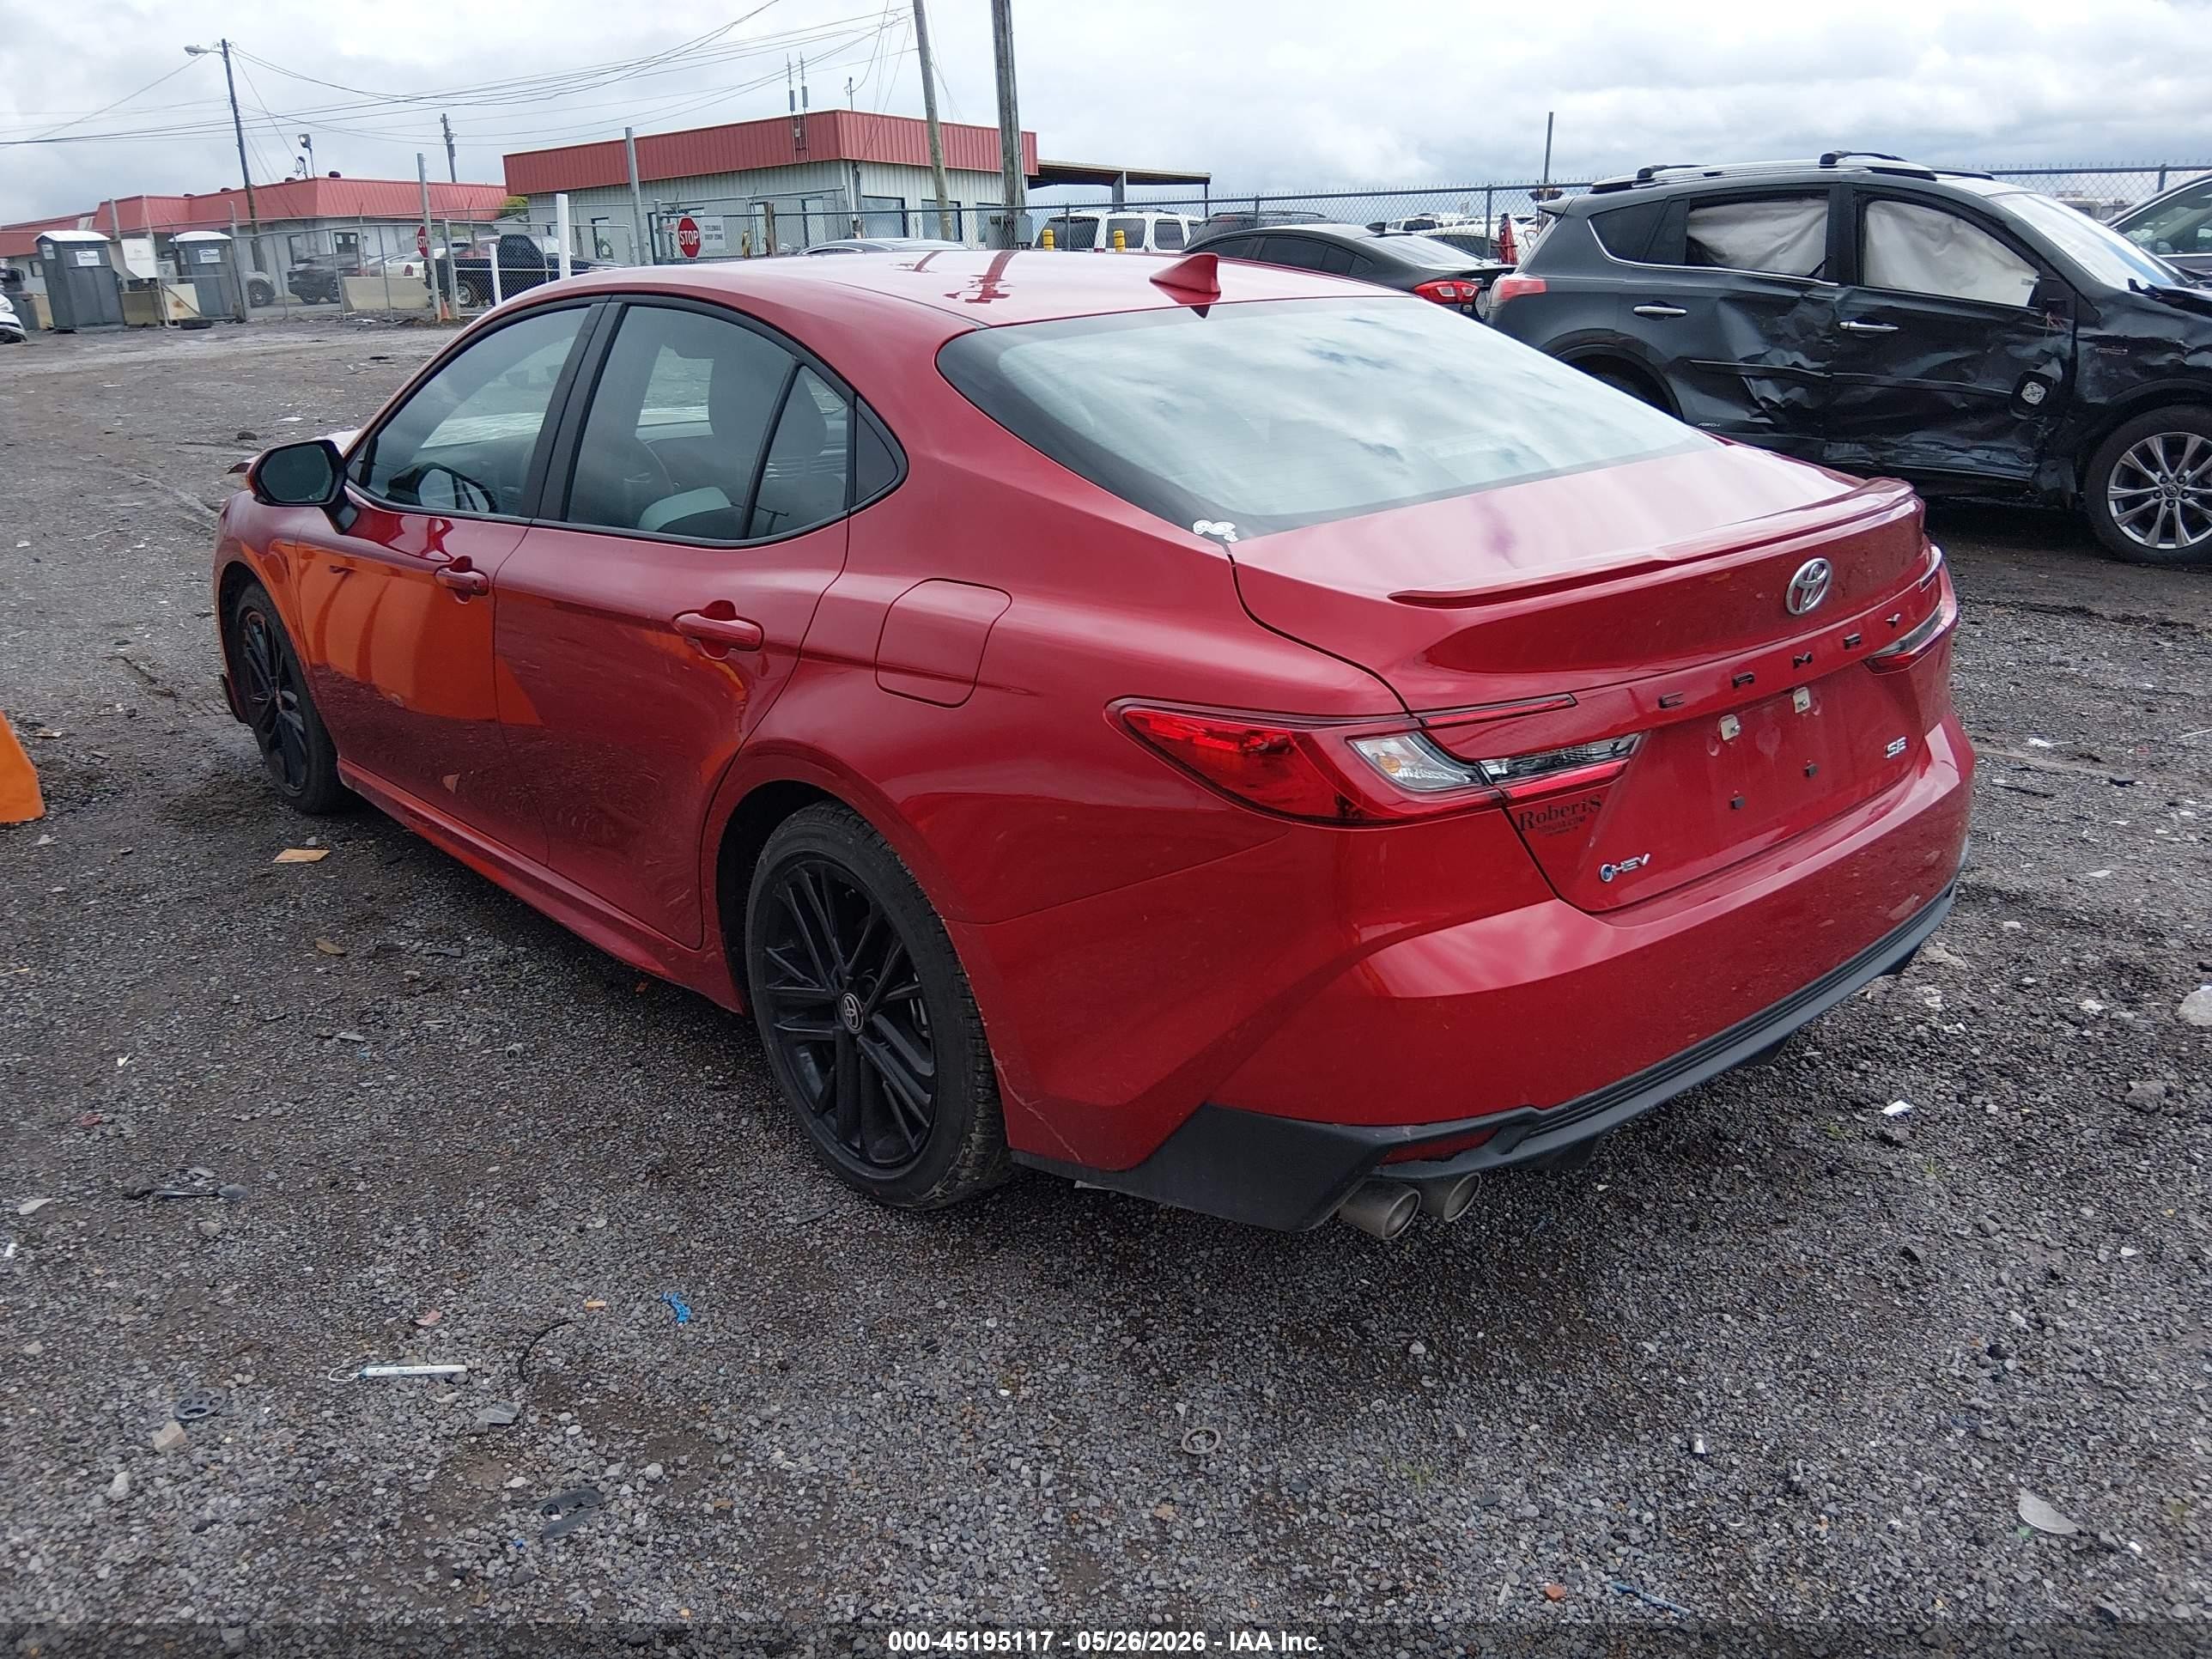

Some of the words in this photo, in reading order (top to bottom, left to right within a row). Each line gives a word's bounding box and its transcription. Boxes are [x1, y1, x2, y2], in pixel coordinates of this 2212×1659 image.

[679, 230, 698, 246] STOP
[1657, 612, 1902, 710] CAMRY
[1885, 736, 1907, 759] SE
